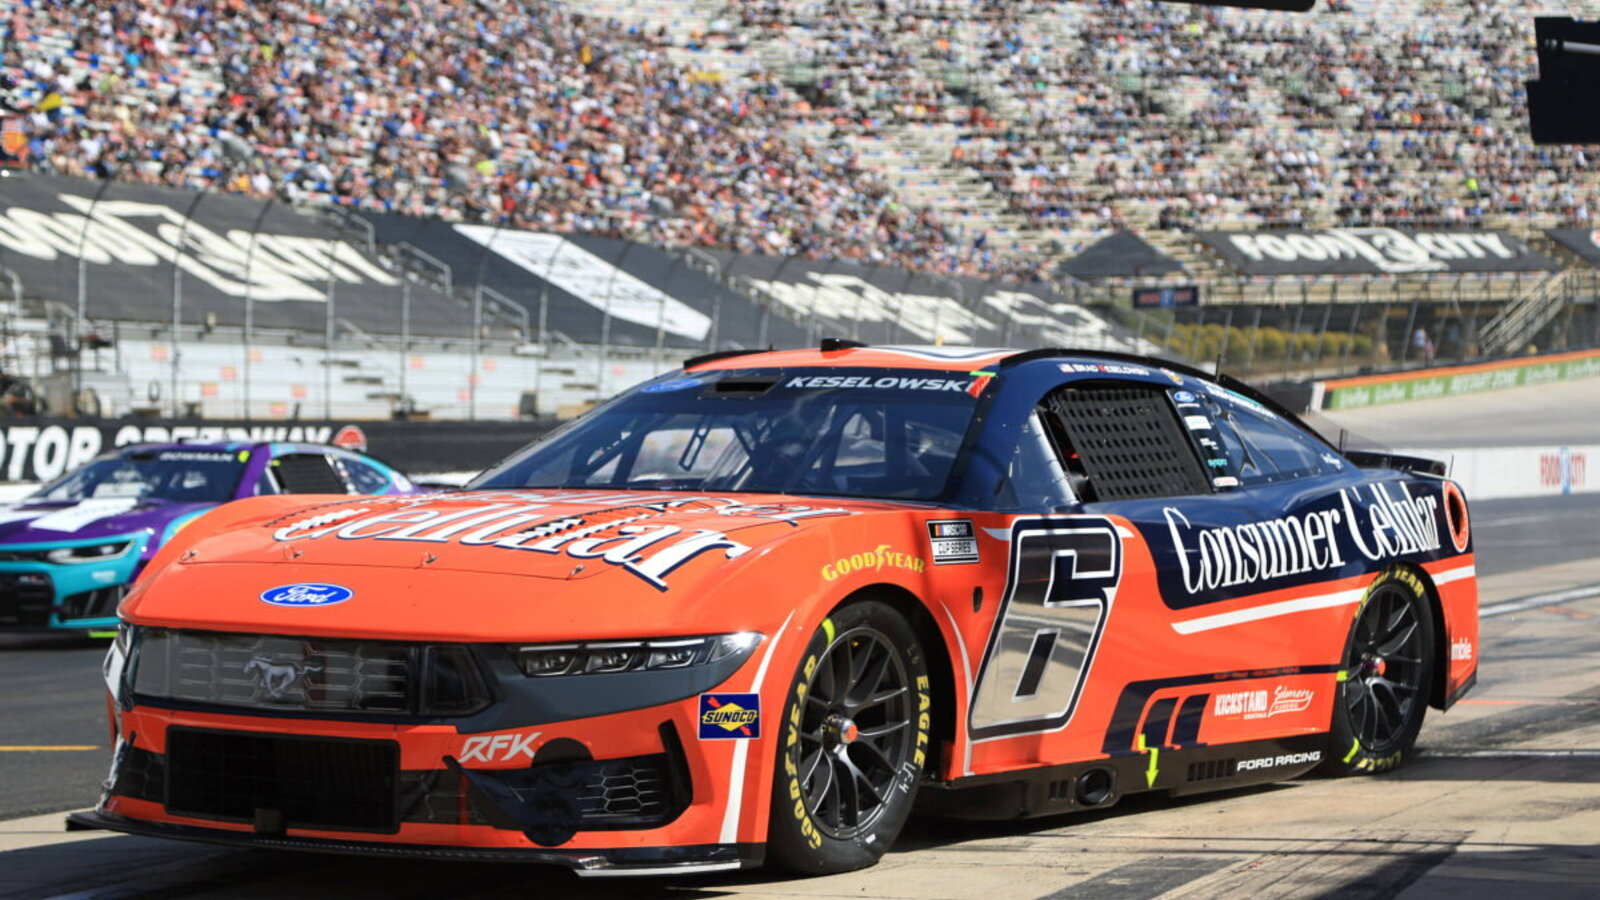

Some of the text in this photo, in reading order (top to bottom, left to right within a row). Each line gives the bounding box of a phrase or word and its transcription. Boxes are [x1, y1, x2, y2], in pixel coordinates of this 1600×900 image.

[1163, 481, 1440, 594] Consumer Cellular
[273, 585, 338, 604] Ford
[965, 515, 1122, 743] 6
[704, 710, 756, 723] SUNOCO
[1214, 690, 1268, 716] KICKSTAND
[913, 675, 931, 770] EAGLE
[458, 732, 543, 763] RFK
[1237, 751, 1322, 772] FORD RACING
